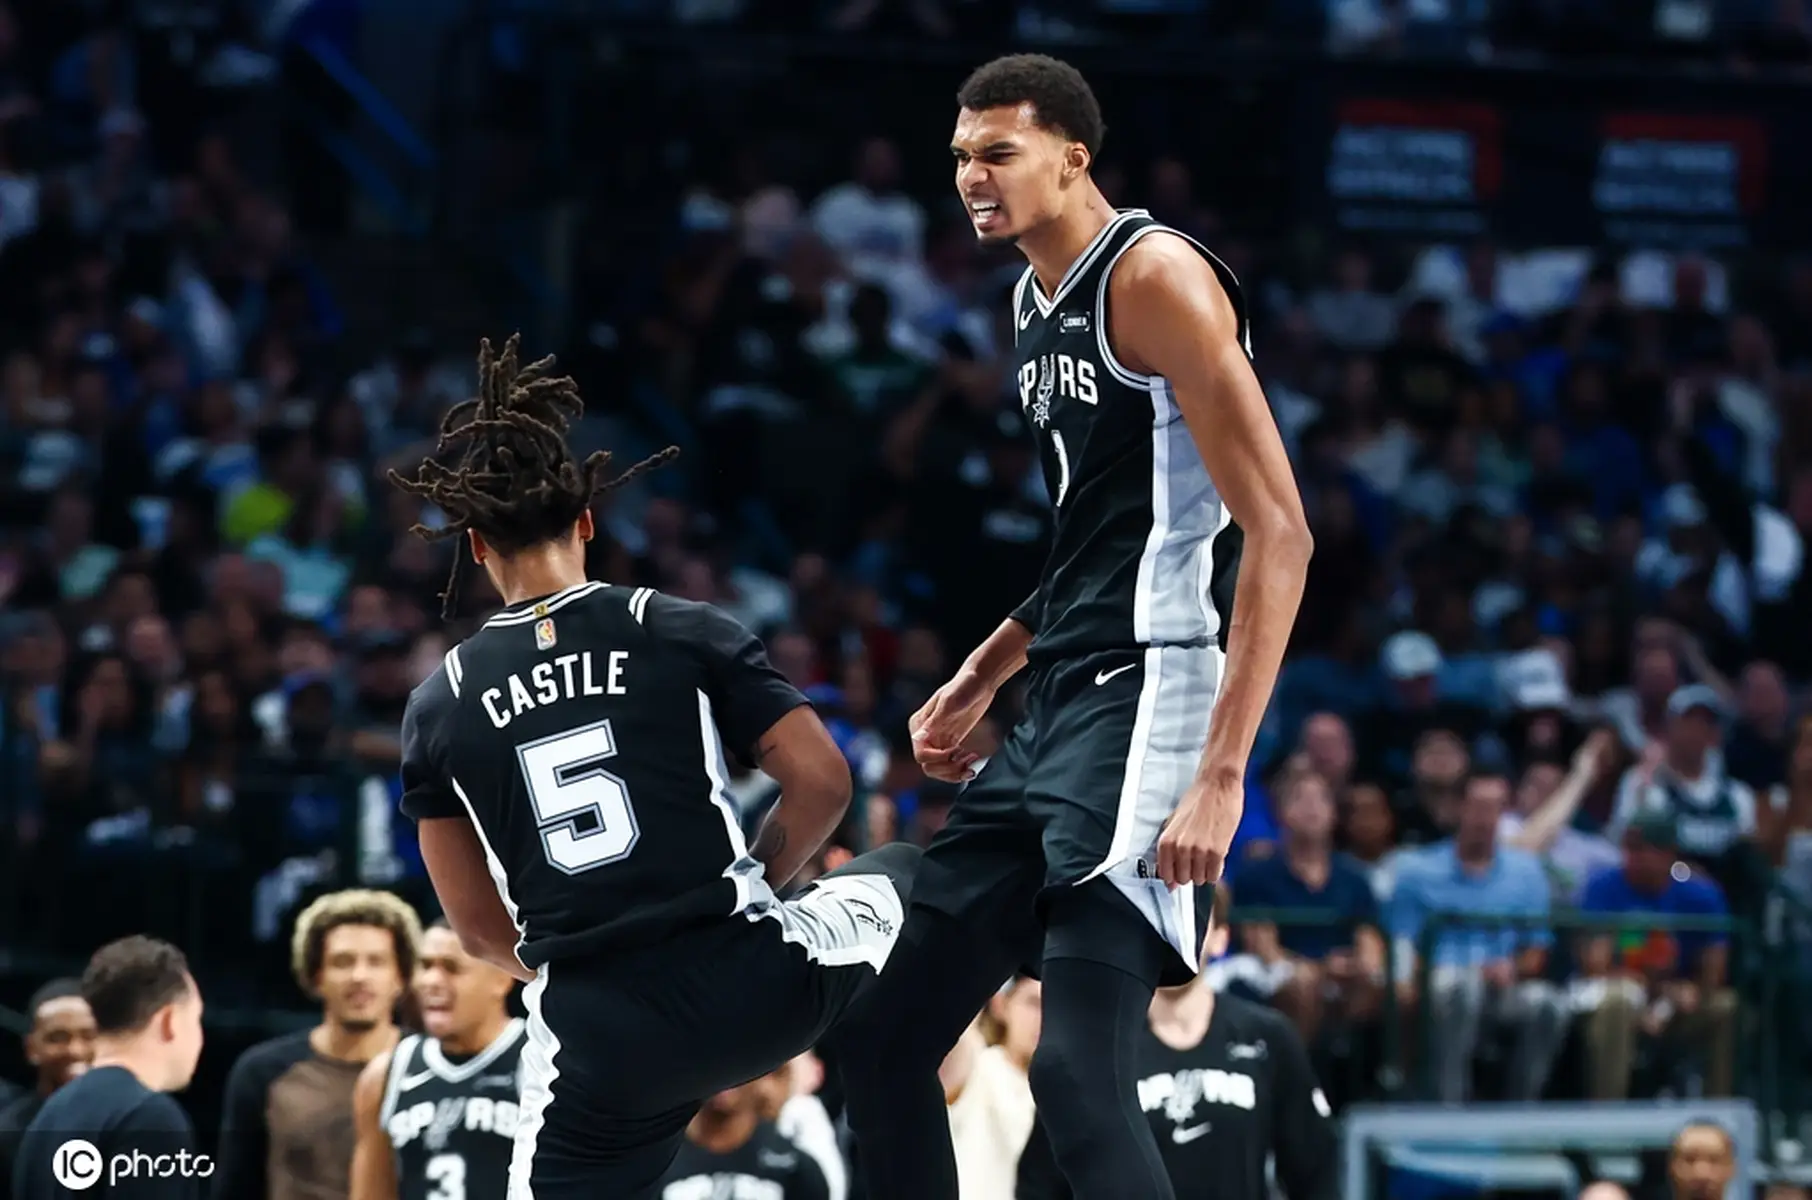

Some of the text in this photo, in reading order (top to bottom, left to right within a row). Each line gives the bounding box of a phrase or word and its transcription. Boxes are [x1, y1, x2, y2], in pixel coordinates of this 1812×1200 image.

[1051, 429, 1070, 507] 1
[481, 650, 629, 729] CASTLE
[515, 718, 641, 876] 5
[425, 1153, 466, 1200] 3
